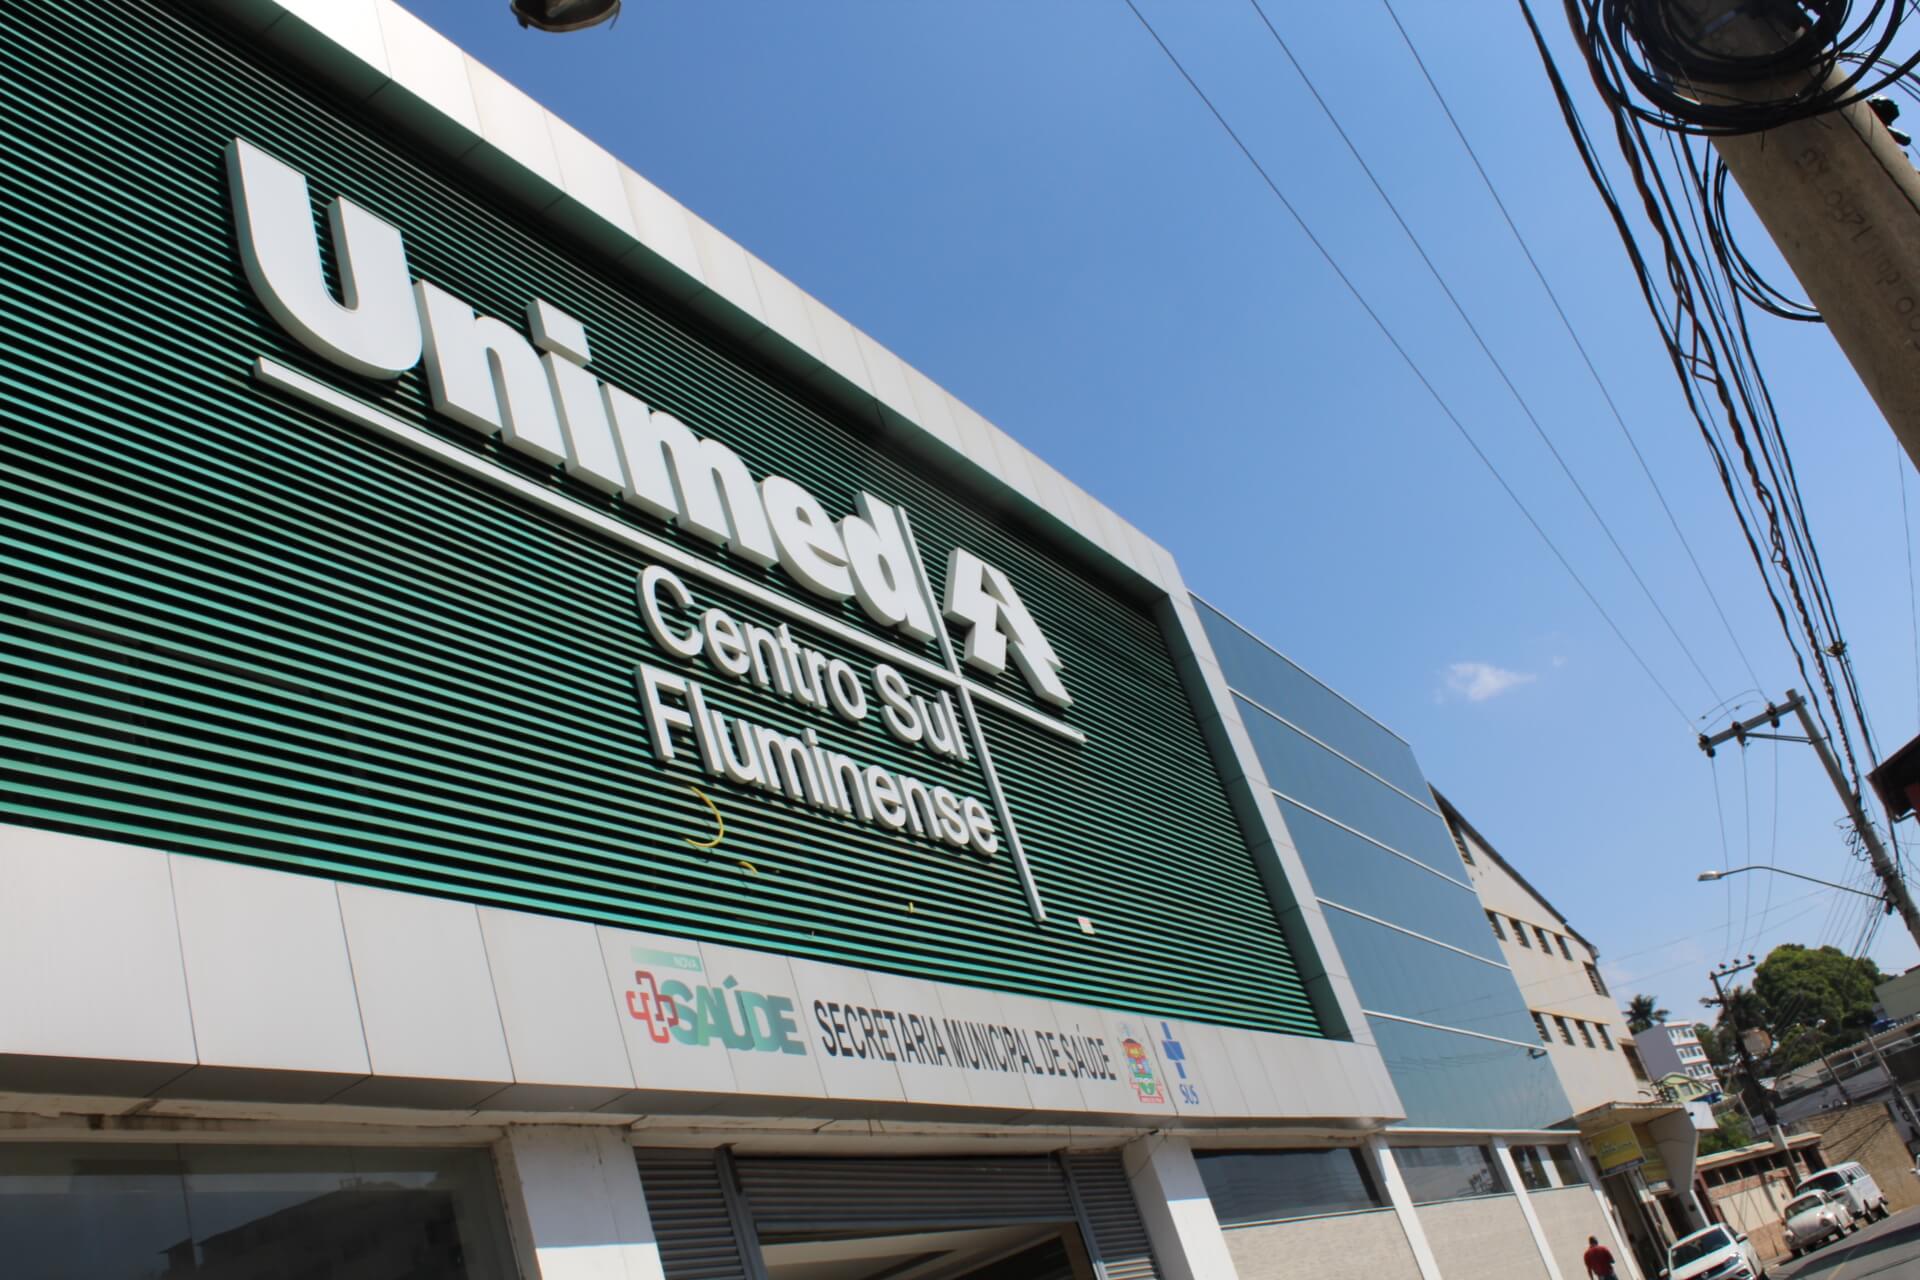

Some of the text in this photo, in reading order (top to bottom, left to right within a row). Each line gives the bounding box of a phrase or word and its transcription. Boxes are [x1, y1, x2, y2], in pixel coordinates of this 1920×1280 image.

[226, 137, 937, 643] Unimed
[636, 565, 968, 761] Centro Sul
[634, 664, 999, 856] Fluminense
[661, 975, 808, 1056] SAÚDE
[814, 999, 1117, 1080] SECRETARIA MUNICIPAL DE SAÚDE
[1179, 1083, 1199, 1104] SUS
